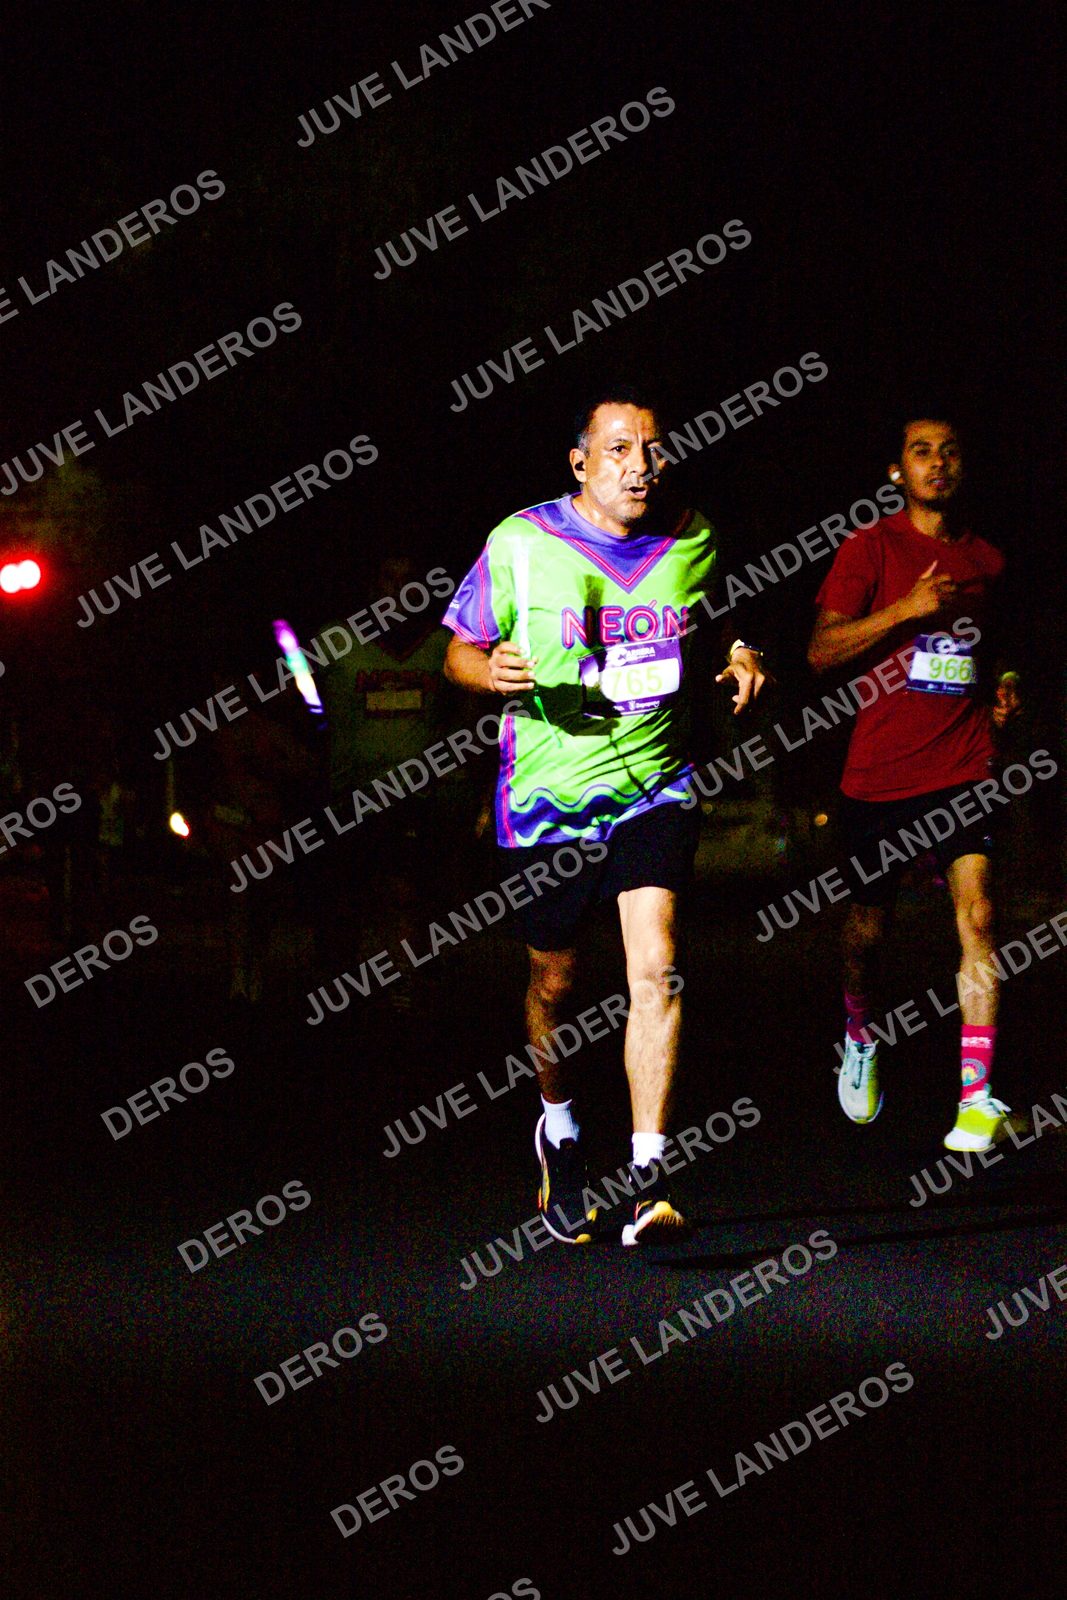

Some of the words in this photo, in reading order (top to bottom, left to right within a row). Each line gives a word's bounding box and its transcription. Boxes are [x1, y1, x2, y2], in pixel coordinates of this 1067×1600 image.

[561, 599, 689, 649] NEÓN
[609, 665, 663, 699] 765
[929, 657, 972, 681] 966
